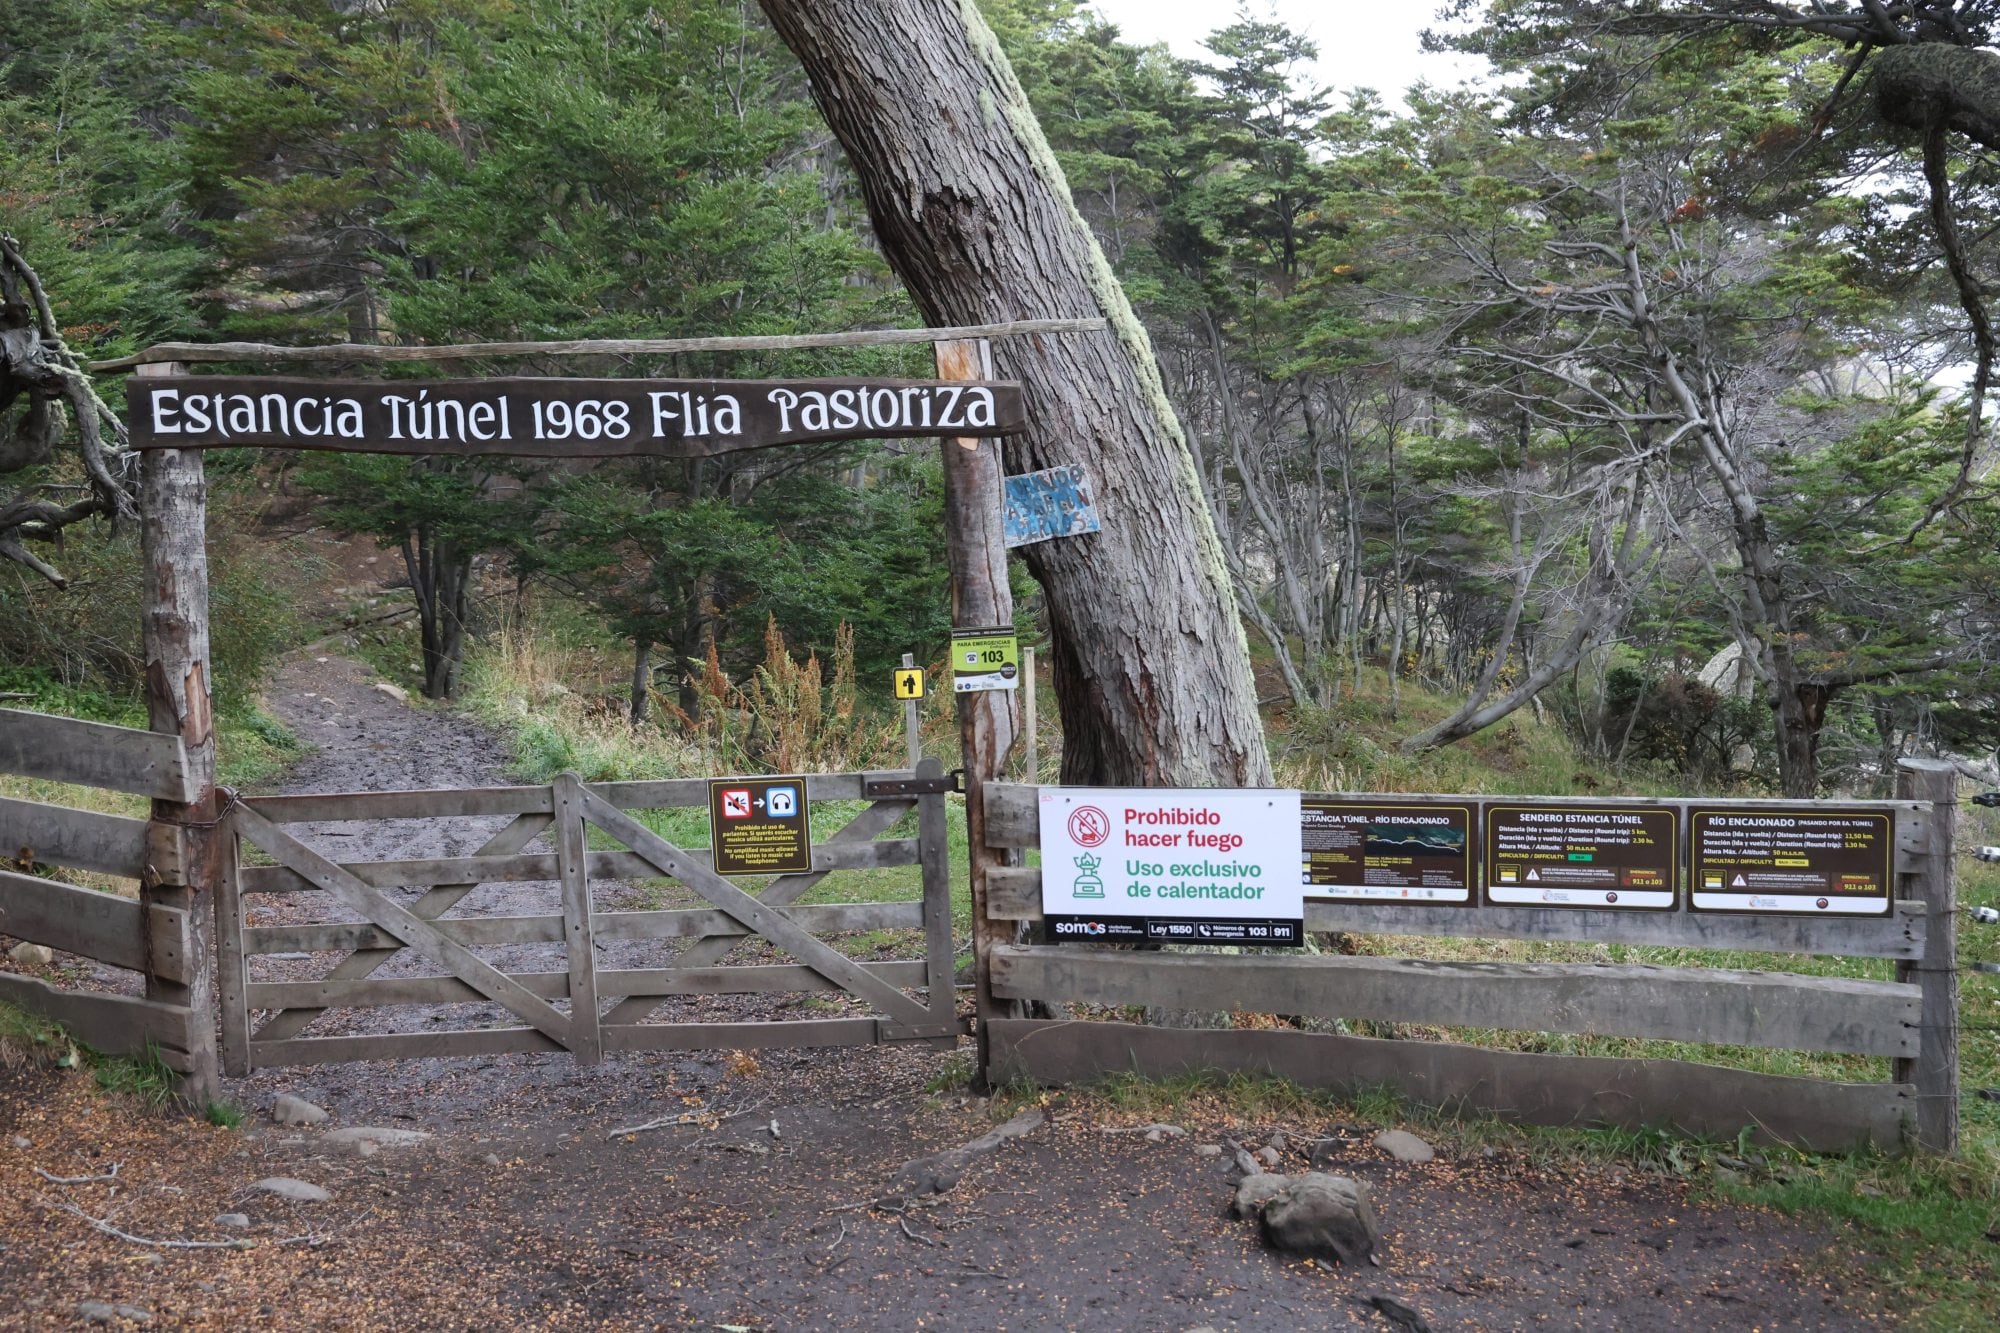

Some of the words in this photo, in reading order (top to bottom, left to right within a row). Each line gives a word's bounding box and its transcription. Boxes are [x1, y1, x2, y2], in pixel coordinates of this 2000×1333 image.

[150, 388, 364, 438] Estancia
[381, 390, 512, 443] Túnel
[530, 399, 630, 439] 1968
[647, 390, 743, 438] Flia
[767, 386, 997, 433] Pastoriza
[981, 650, 1004, 663] 103
[1124, 808, 1220, 825] Prohibido
[1342, 815, 1370, 823] TÚNEL
[1376, 815, 1390, 823] RÍO
[1520, 814, 1563, 822] SENDERO
[1566, 815, 1609, 823] ESTANCIA
[1612, 814, 1642, 824] TÚNEL
[1708, 816, 1726, 825] RÍO
[1729, 818, 1795, 826] ENCAJONADO
[1125, 830, 1181, 847] hacer
[1187, 831, 1243, 852] fuego
[1126, 860, 1164, 876] Uso
[1169, 860, 1262, 877] exclusivo
[1126, 881, 1151, 898] de
[1157, 882, 1265, 900] calentador
[1151, 925, 1167, 935] Ley
[1169, 925, 1192, 934] 1550
[1248, 927, 1267, 936] 103
[1274, 927, 1290, 936] 911
